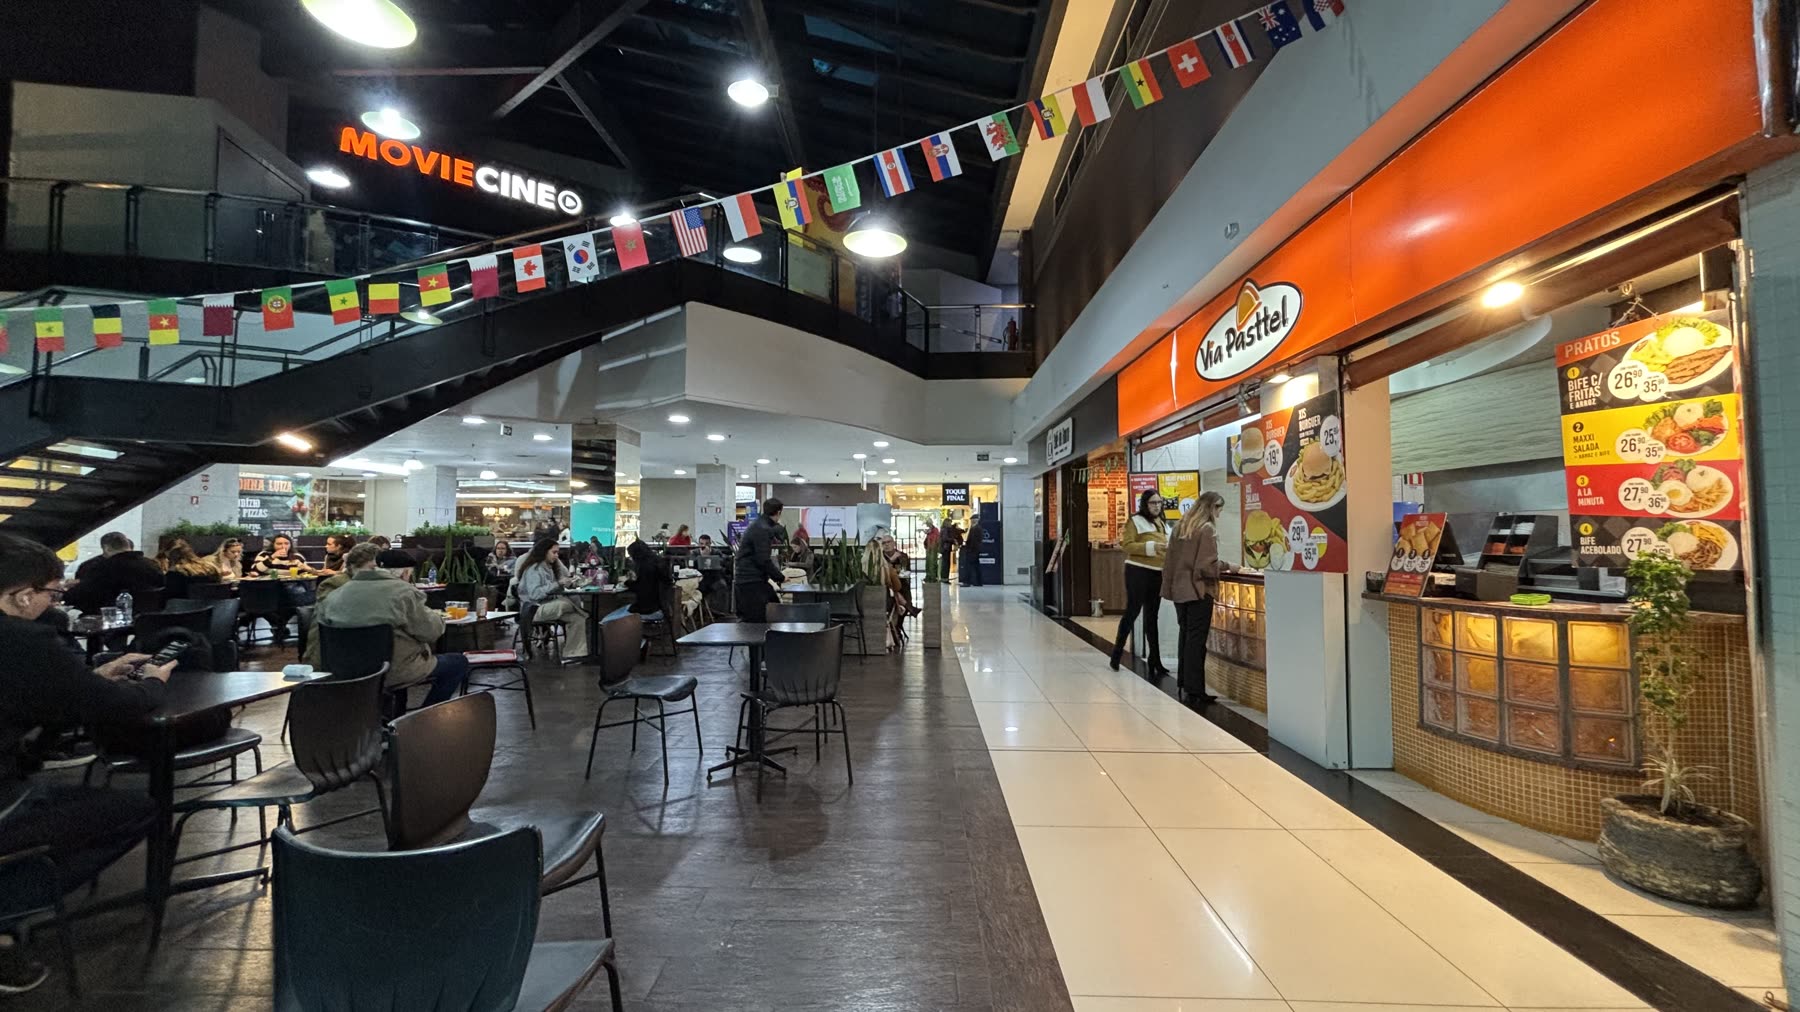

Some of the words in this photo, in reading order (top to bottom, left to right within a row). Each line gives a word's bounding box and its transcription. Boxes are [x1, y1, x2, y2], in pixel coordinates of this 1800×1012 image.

[1200, 340, 1222, 372] Via
[1224, 295, 1288, 358] Pasttel
[1564, 331, 1621, 359] PRATOS
[1568, 376, 1589, 392] BIFE
[1590, 372, 1603, 388] C/
[1569, 385, 1601, 402] FRITAS
[1575, 398, 1597, 409] ARROZ
[1298, 408, 1307, 420] XIS
[1573, 434, 1595, 444] MAXXI
[1573, 442, 1600, 454] SALADA
[268, 480, 293, 492] LUIZA
[1578, 488, 1583, 496] A
[1584, 488, 1592, 496] LA
[1578, 496, 1604, 506] MINUTA
[242, 508, 269, 518] PIZZAS
[1580, 536, 1596, 546] BIFE
[1626, 538, 1652, 554] 2790
[1580, 546, 1622, 555] ACEBOLADO
